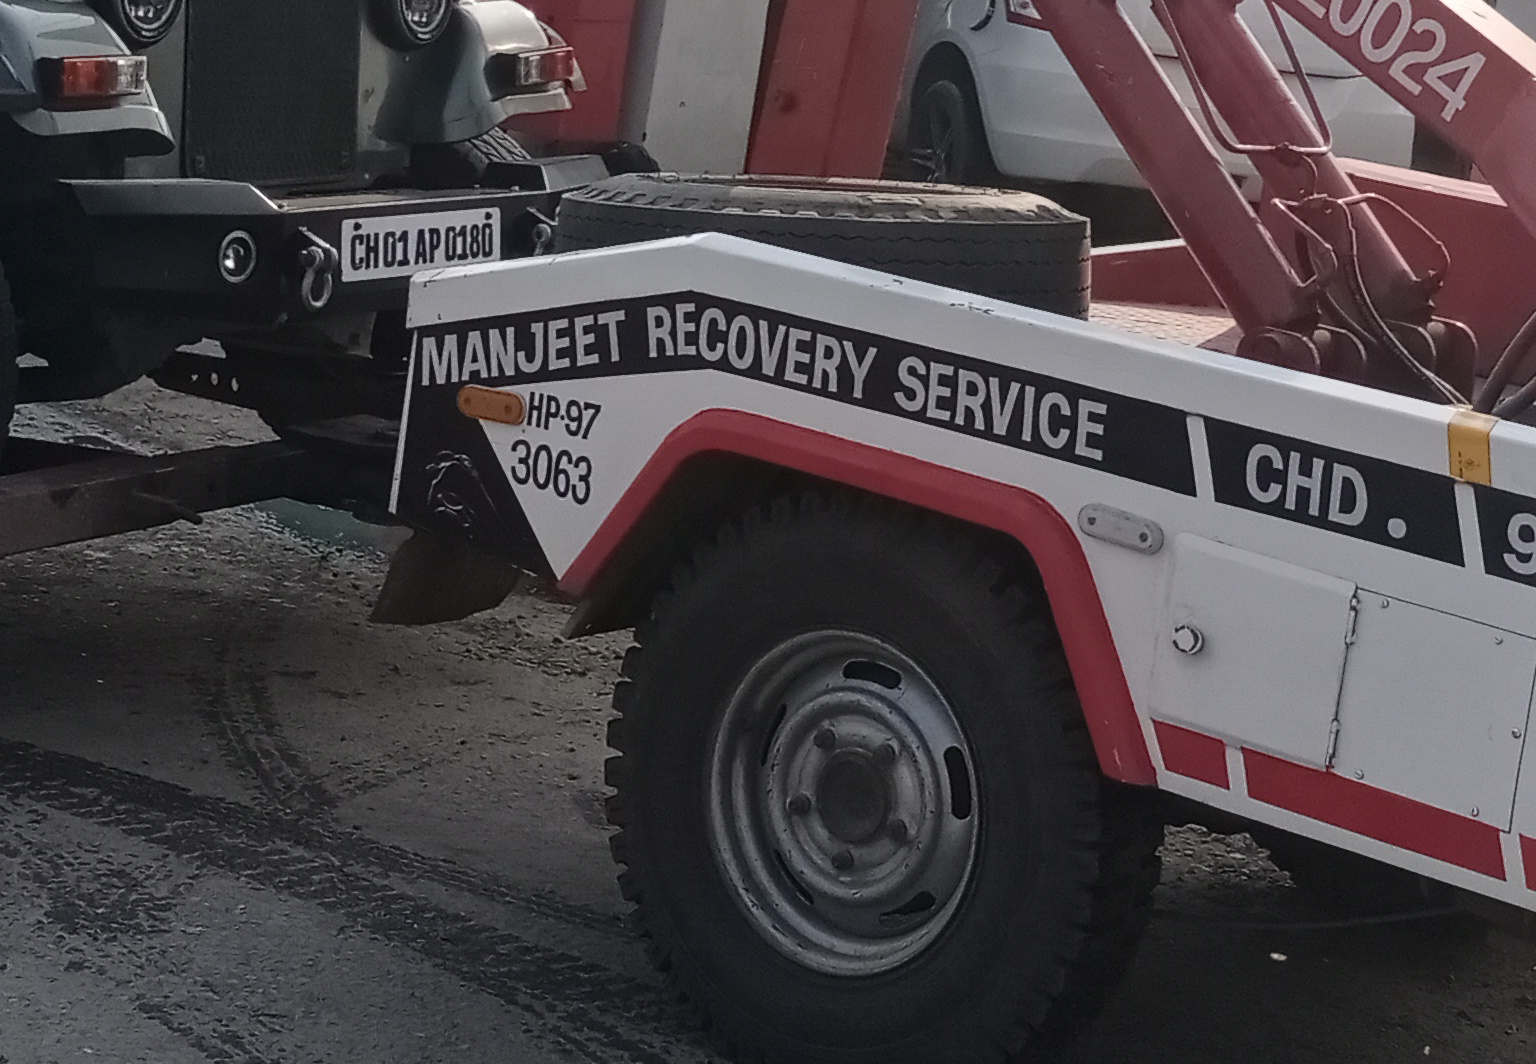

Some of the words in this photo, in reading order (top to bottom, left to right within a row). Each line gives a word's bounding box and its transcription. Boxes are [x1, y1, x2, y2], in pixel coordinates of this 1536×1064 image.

[350, 232, 379, 271] CH
[383, 229, 410, 268] 01
[414, 227, 441, 266] AP
[445, 222, 494, 262] 0180
[421, 310, 625, 387] MANJEET
[647, 301, 878, 401] RECOVERY
[895, 354, 1109, 462] SERVICE
[511, 440, 593, 505] 3063
